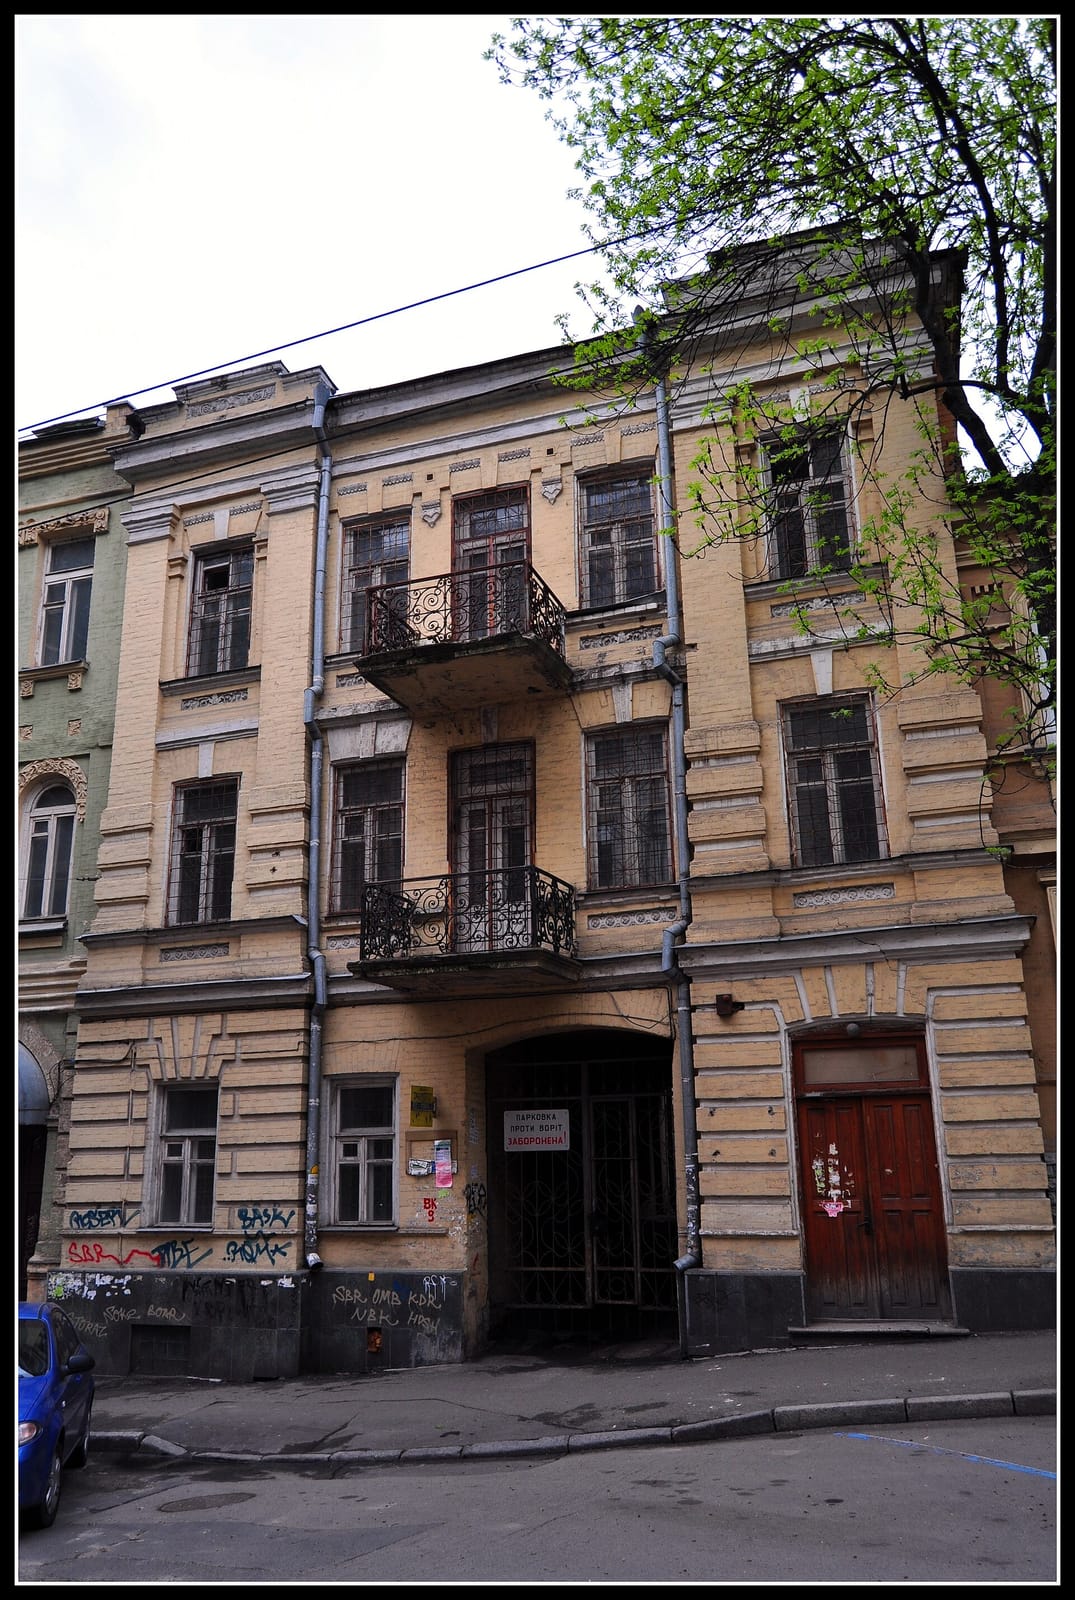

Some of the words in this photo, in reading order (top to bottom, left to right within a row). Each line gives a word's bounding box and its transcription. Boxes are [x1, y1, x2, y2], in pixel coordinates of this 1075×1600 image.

[516, 1113, 556, 1121] ПАРКОВКА
[510, 1125, 535, 1133] ПРОТИ
[539, 1124, 563, 1132] ВОРІТ
[507, 1131, 567, 1146] ЗАБОРОНЕНА!
[332, 1285, 367, 1304] SBR
[372, 1287, 402, 1306] OMB
[408, 1290, 442, 1310] KDR
